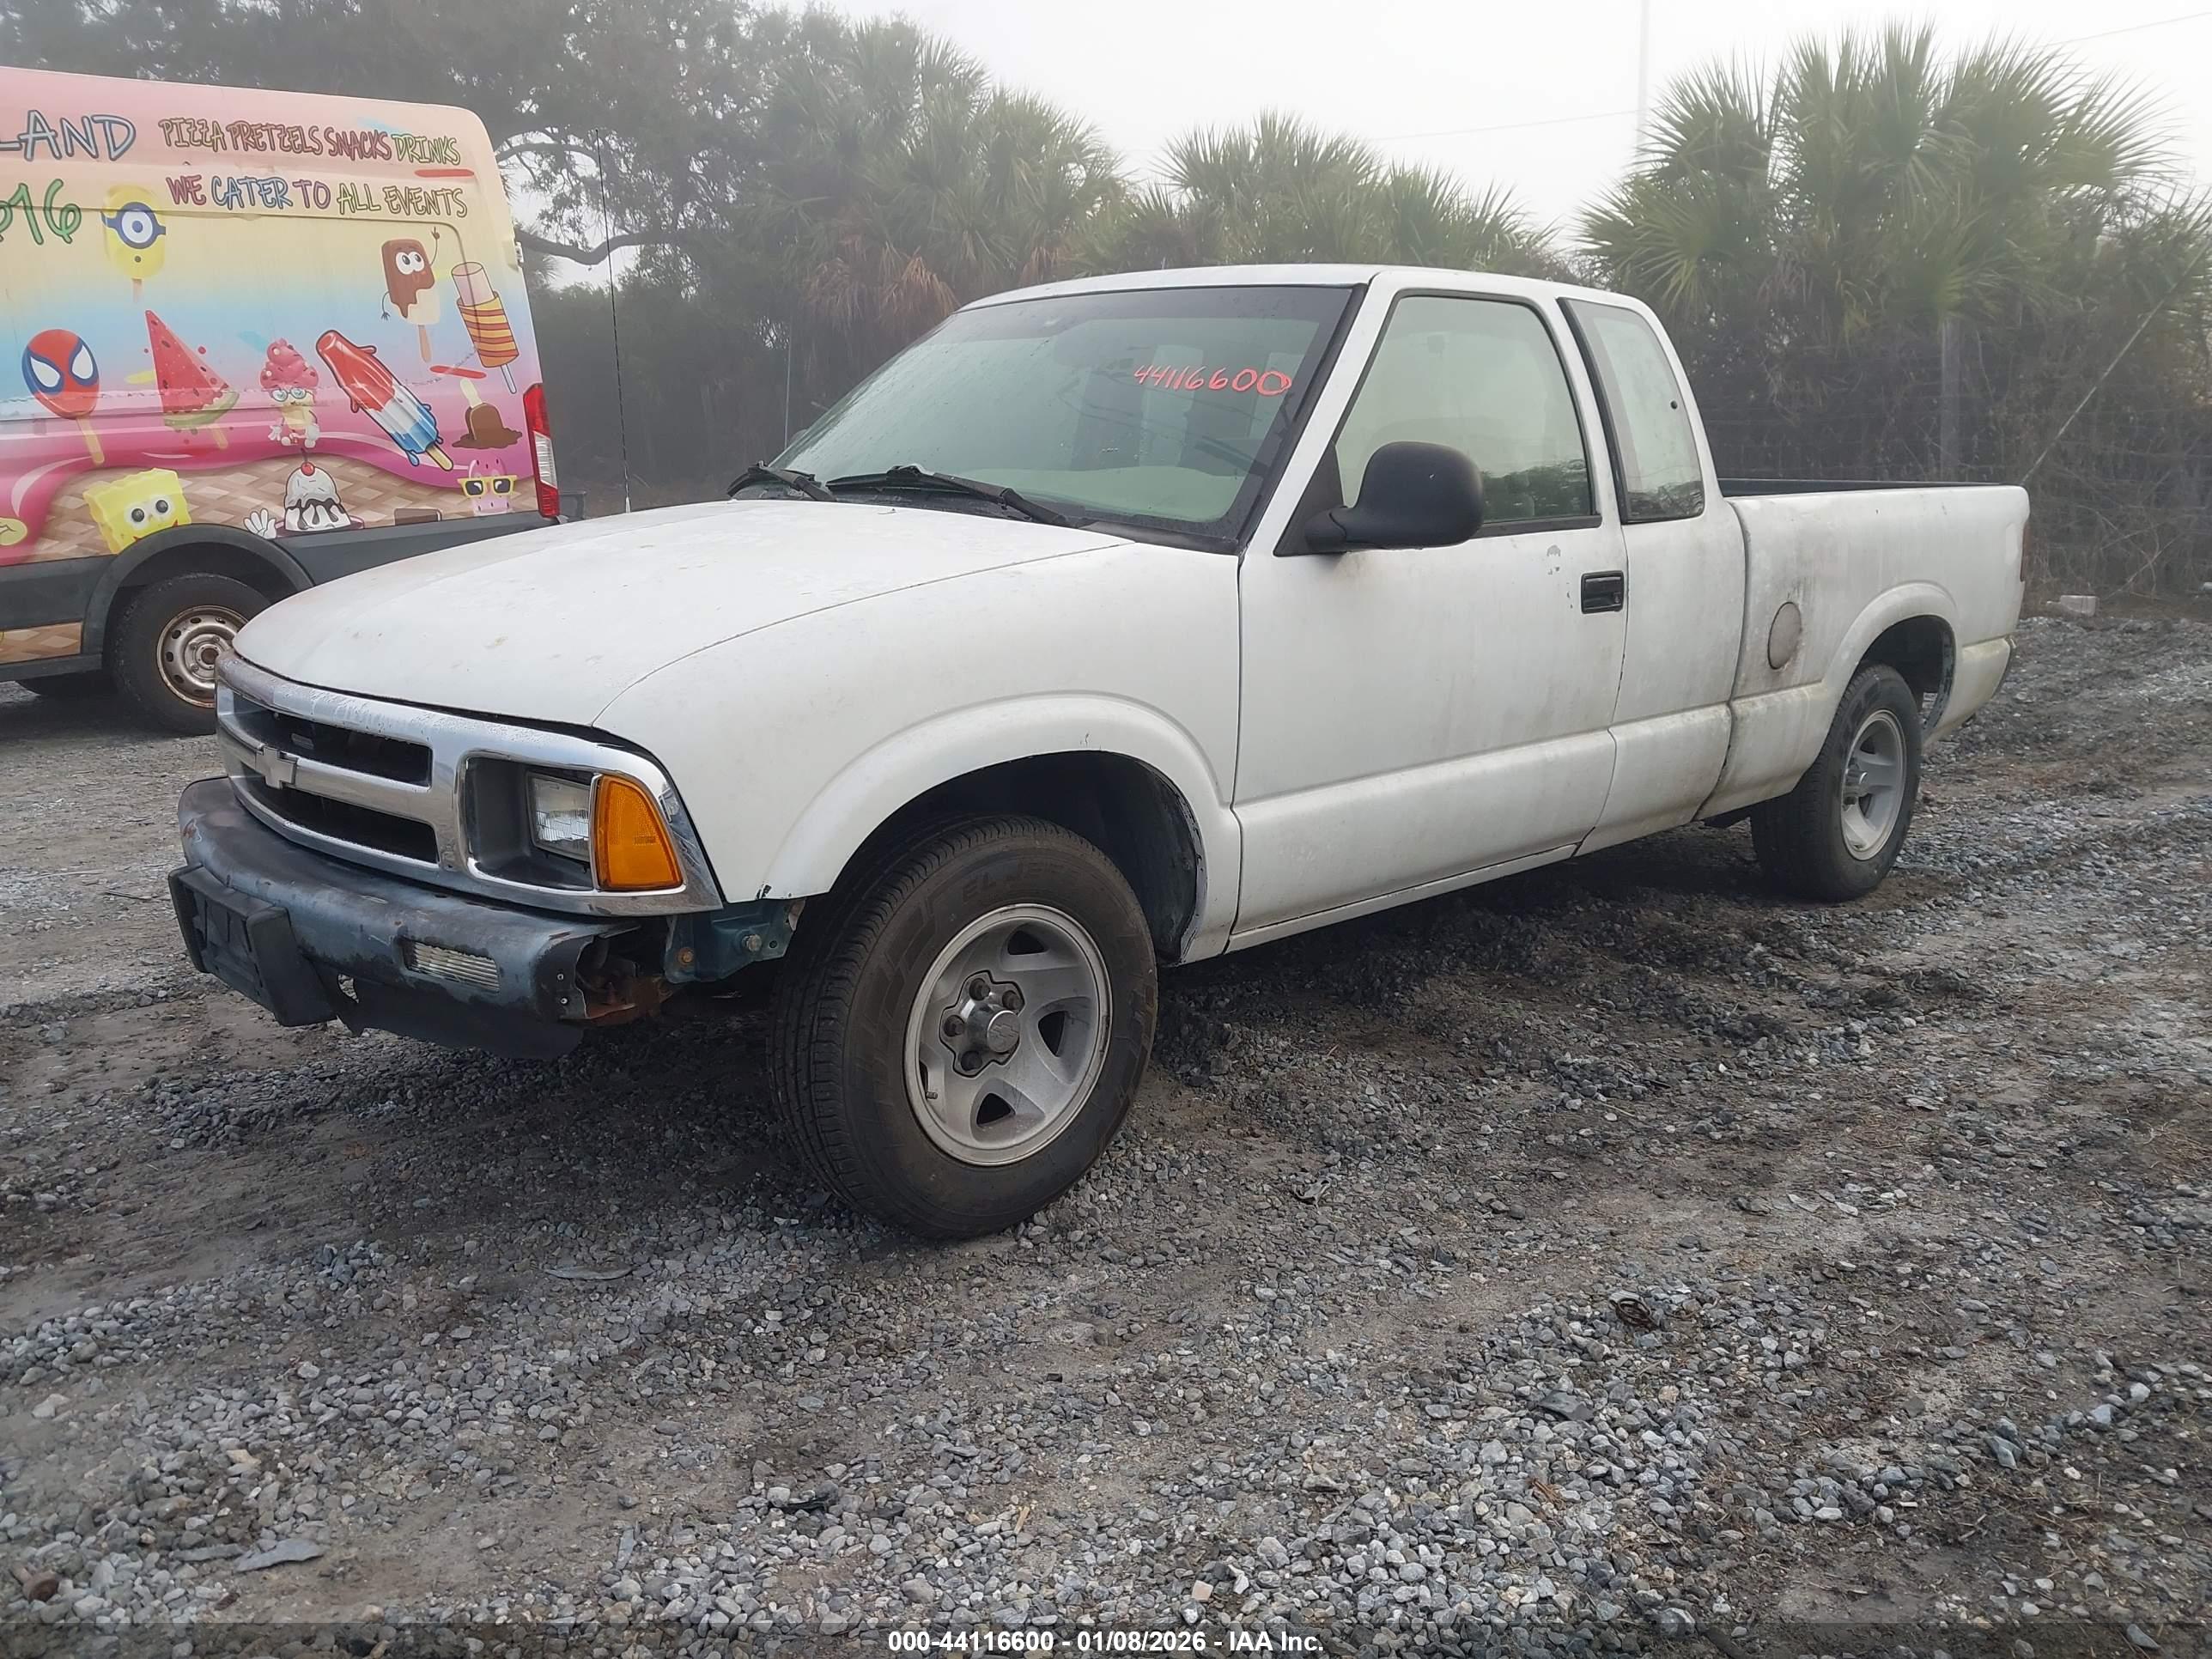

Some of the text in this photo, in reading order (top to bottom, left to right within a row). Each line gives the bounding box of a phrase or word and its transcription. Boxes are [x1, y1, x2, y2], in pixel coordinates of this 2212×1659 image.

[158, 117, 460, 166] PIZZA PRETZELS SNACKS DRINKS
[166, 174, 467, 218] WE CATER TO ALL EVENTS
[1133, 364, 1291, 396] 44116600
